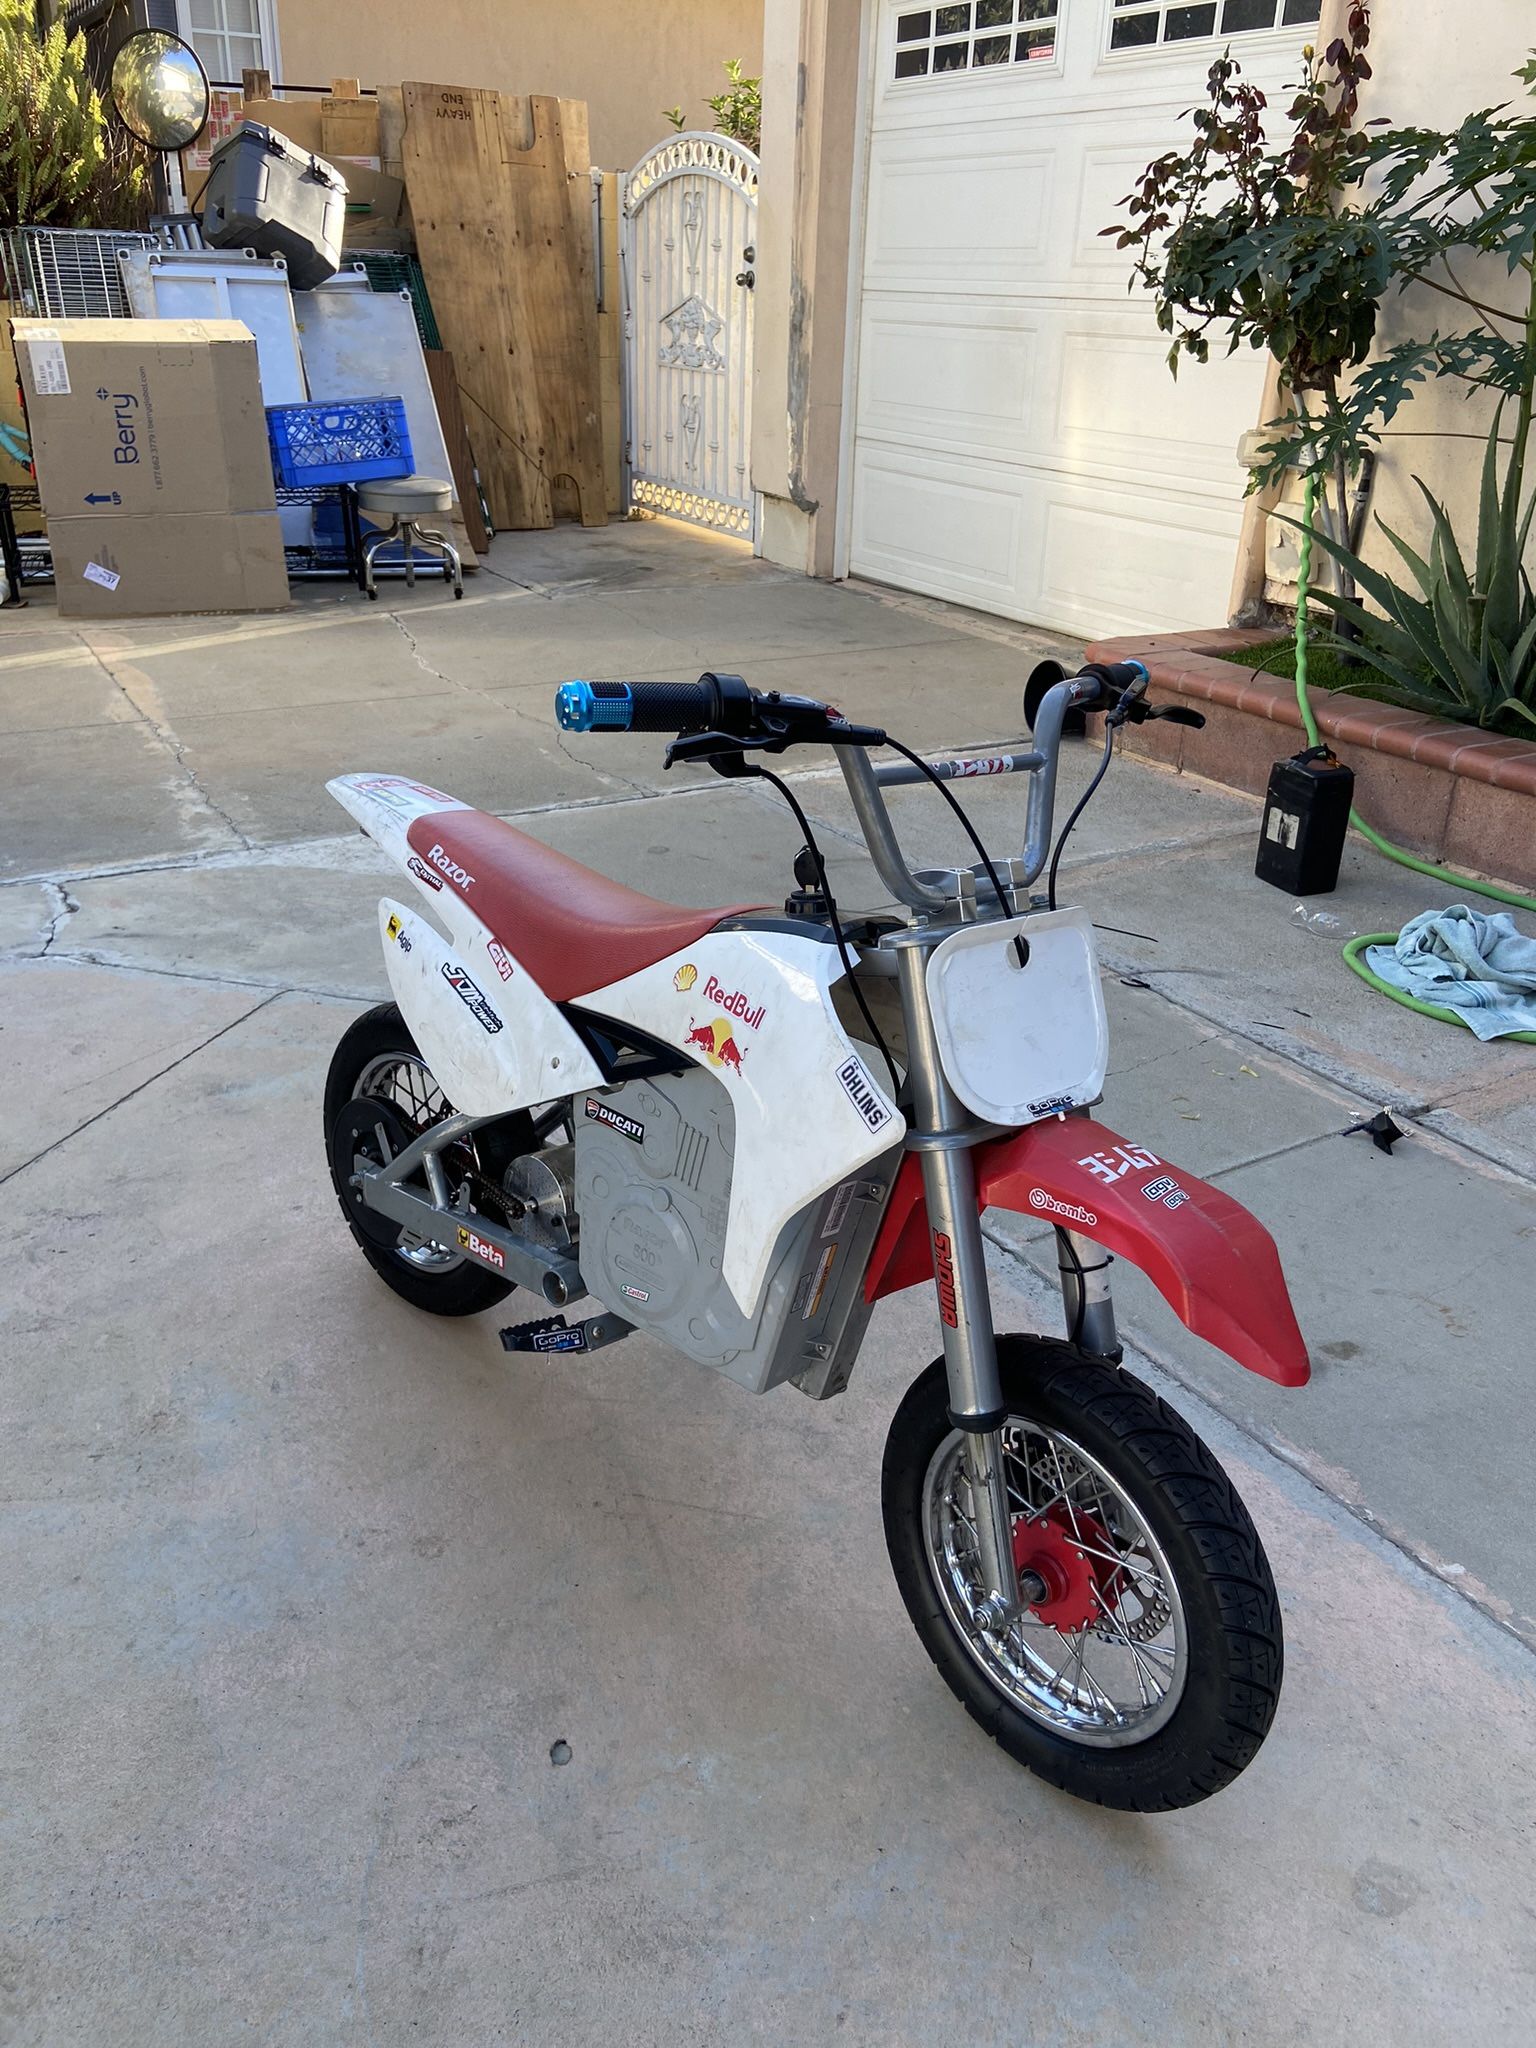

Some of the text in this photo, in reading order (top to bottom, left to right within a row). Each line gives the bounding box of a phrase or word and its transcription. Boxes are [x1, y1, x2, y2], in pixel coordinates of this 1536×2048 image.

[441, 93, 464, 105] END
[436, 108, 471, 120] HEAVY
[113, 394, 139, 464] Berry
[112, 491, 122, 505] UP
[427, 844, 476, 889] Razor
[397, 930, 412, 952] Agip
[470, 1001, 500, 1033] POWER
[841, 1061, 884, 1126] ÖHLINS
[1027, 1094, 1073, 1112] GoPro
[600, 1108, 643, 1136] DUCATI
[1047, 1195, 1096, 1224] brembo
[469, 1233, 503, 1268] Beta
[933, 1227, 958, 1329] SHOWA
[628, 1288, 647, 1299] Castrol
[539, 1332, 579, 1346] GoPro
